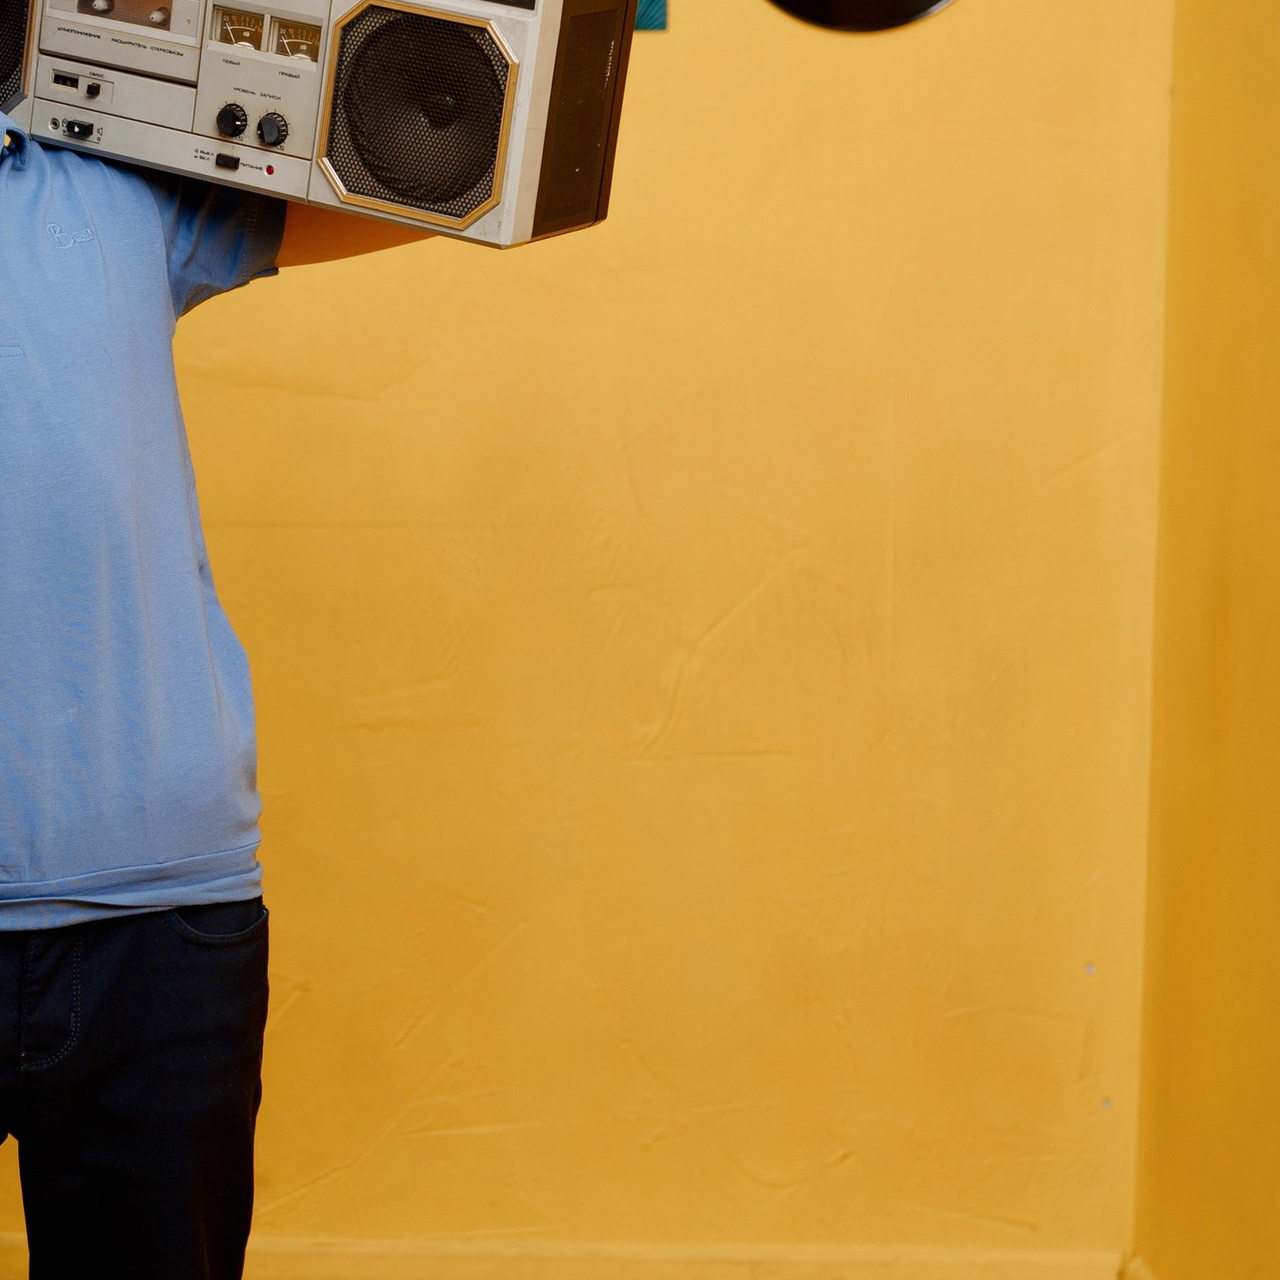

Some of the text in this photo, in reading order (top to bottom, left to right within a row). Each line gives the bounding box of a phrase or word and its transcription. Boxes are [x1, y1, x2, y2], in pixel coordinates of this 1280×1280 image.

[233, 86, 282, 101] УРОВЕНЬ ЗАПИСИ
[240, 162, 264, 172] ПИТАНИЕ
